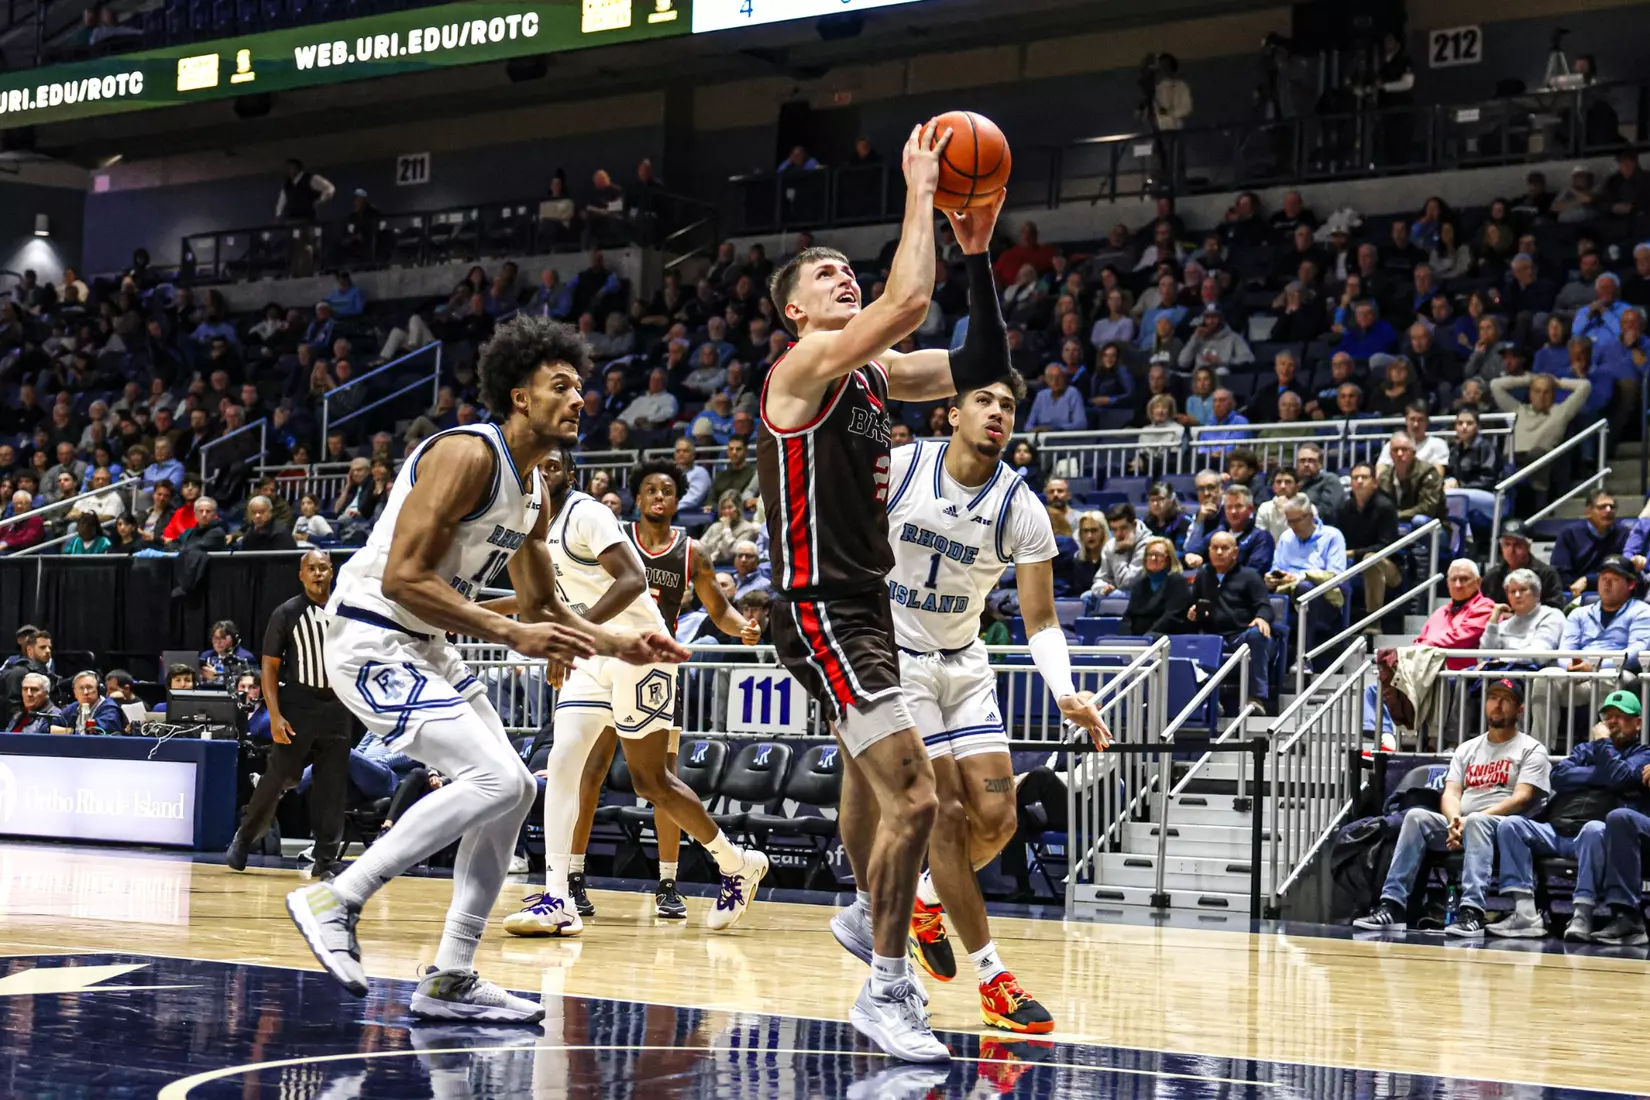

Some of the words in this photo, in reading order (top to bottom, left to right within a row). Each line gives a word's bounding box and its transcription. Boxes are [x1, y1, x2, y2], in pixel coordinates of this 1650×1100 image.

[294, 12, 540, 70] WEB.URI.EDU/ROTC
[1433, 29, 1479, 63] 212
[400, 157, 426, 182] 211
[900, 522, 980, 565] RHODE
[924, 552, 942, 590] 1
[889, 580, 970, 613] ISLAND
[738, 675, 792, 725] 111
[1466, 759, 1513, 777] KNIGHT
[25, 785, 73, 813] Ortho
[75, 788, 130, 816] Rhode
[133, 791, 185, 819] Island
